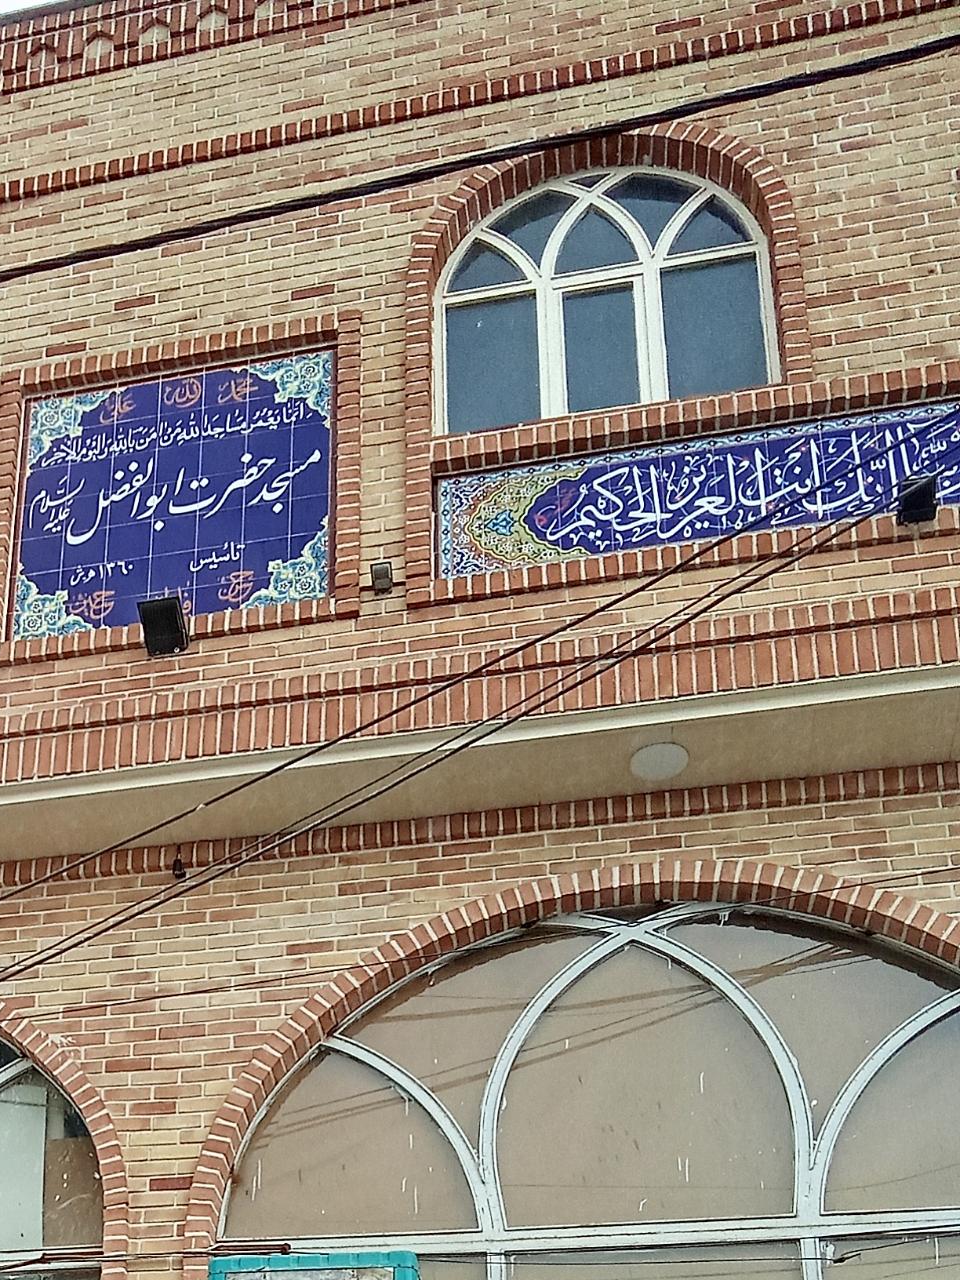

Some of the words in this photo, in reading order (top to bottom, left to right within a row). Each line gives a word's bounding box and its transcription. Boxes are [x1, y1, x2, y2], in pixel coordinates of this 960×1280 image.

[162, 376, 202, 408] الله
[66, 457, 185, 545] ابوالفضل
[168, 452, 277, 519] حضرت
[246, 449, 322, 514] مسجد
